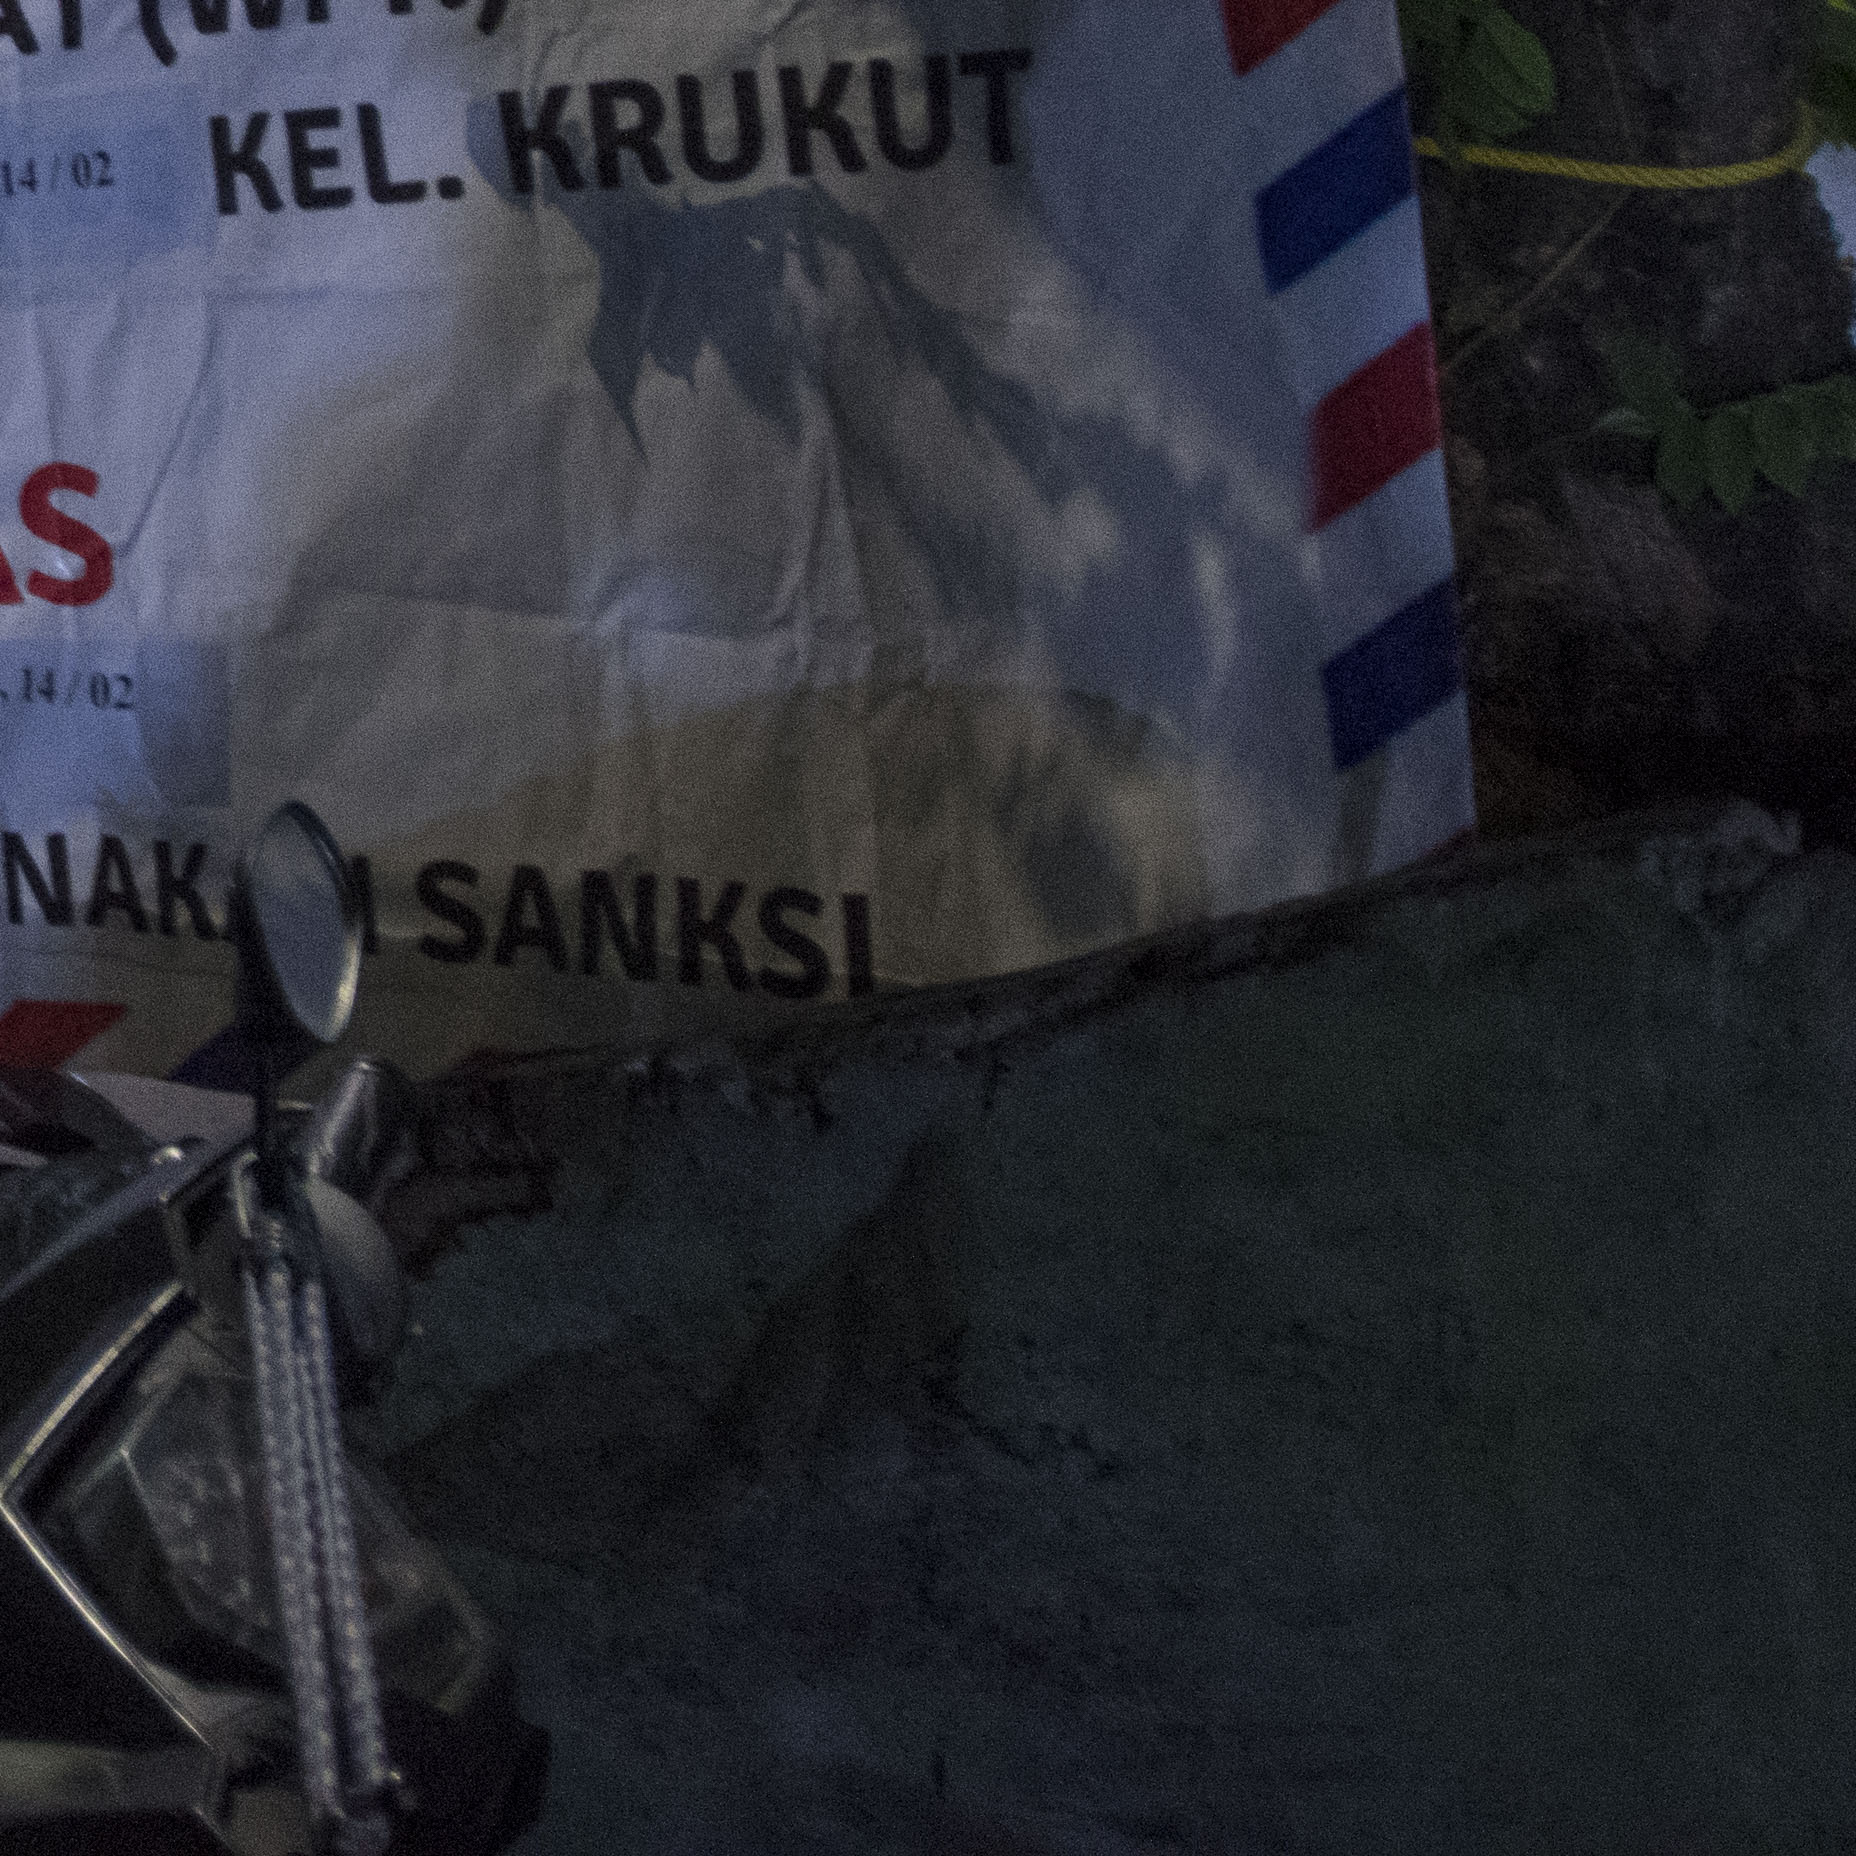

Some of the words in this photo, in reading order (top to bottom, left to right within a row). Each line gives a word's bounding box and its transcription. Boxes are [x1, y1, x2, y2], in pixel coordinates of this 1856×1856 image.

[209, 103, 465, 216] KEL.
[497, 49, 1034, 194] KRUKUT
[415, 859, 876, 999] SANKSI
